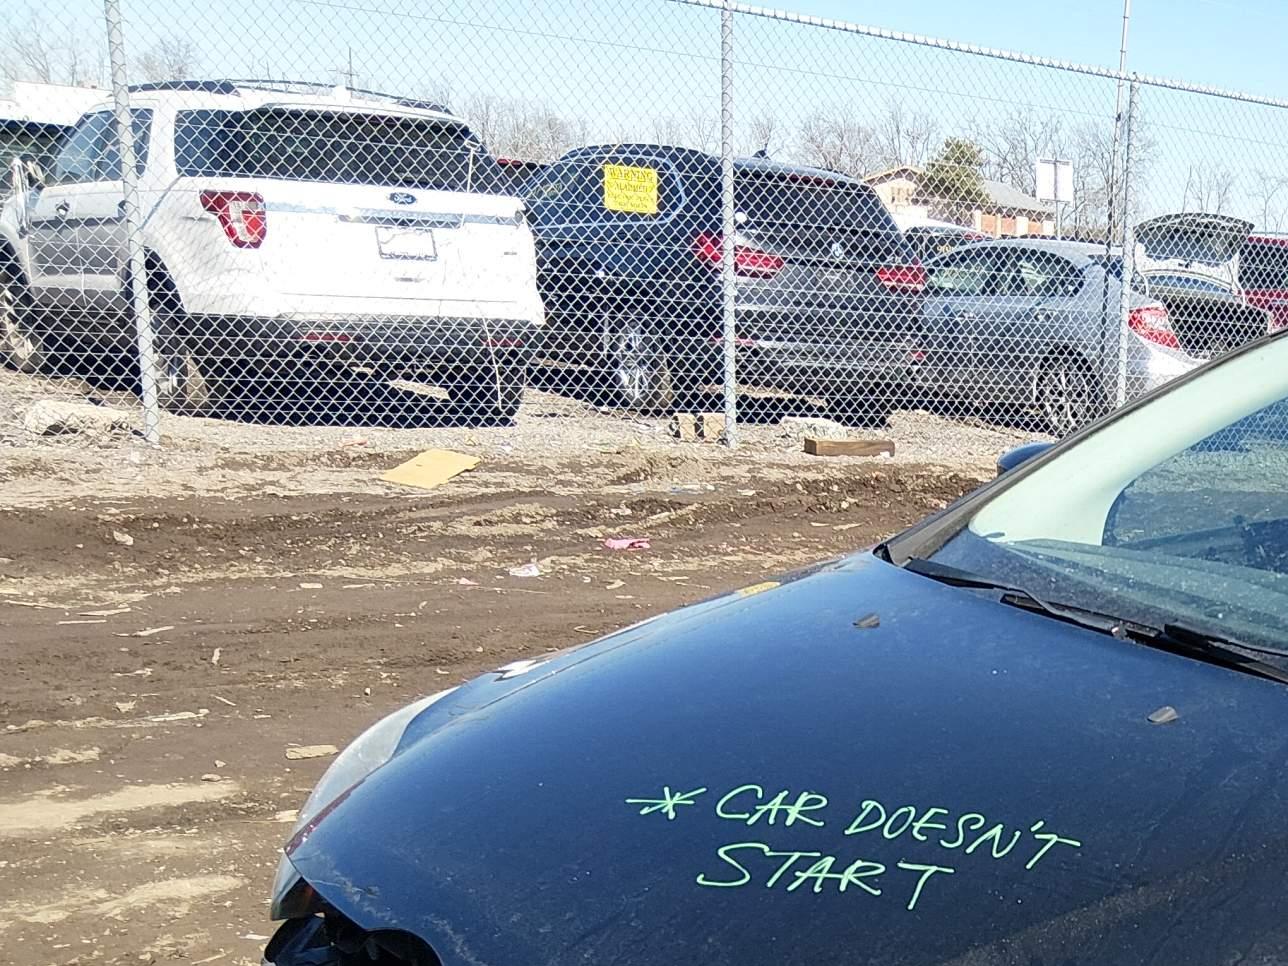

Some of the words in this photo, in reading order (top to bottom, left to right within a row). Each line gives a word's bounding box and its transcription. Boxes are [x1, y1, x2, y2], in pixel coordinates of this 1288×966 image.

[714, 784, 828, 828] CAR
[843, 800, 1082, 870] DOESN'T
[696, 842, 956, 911] START
